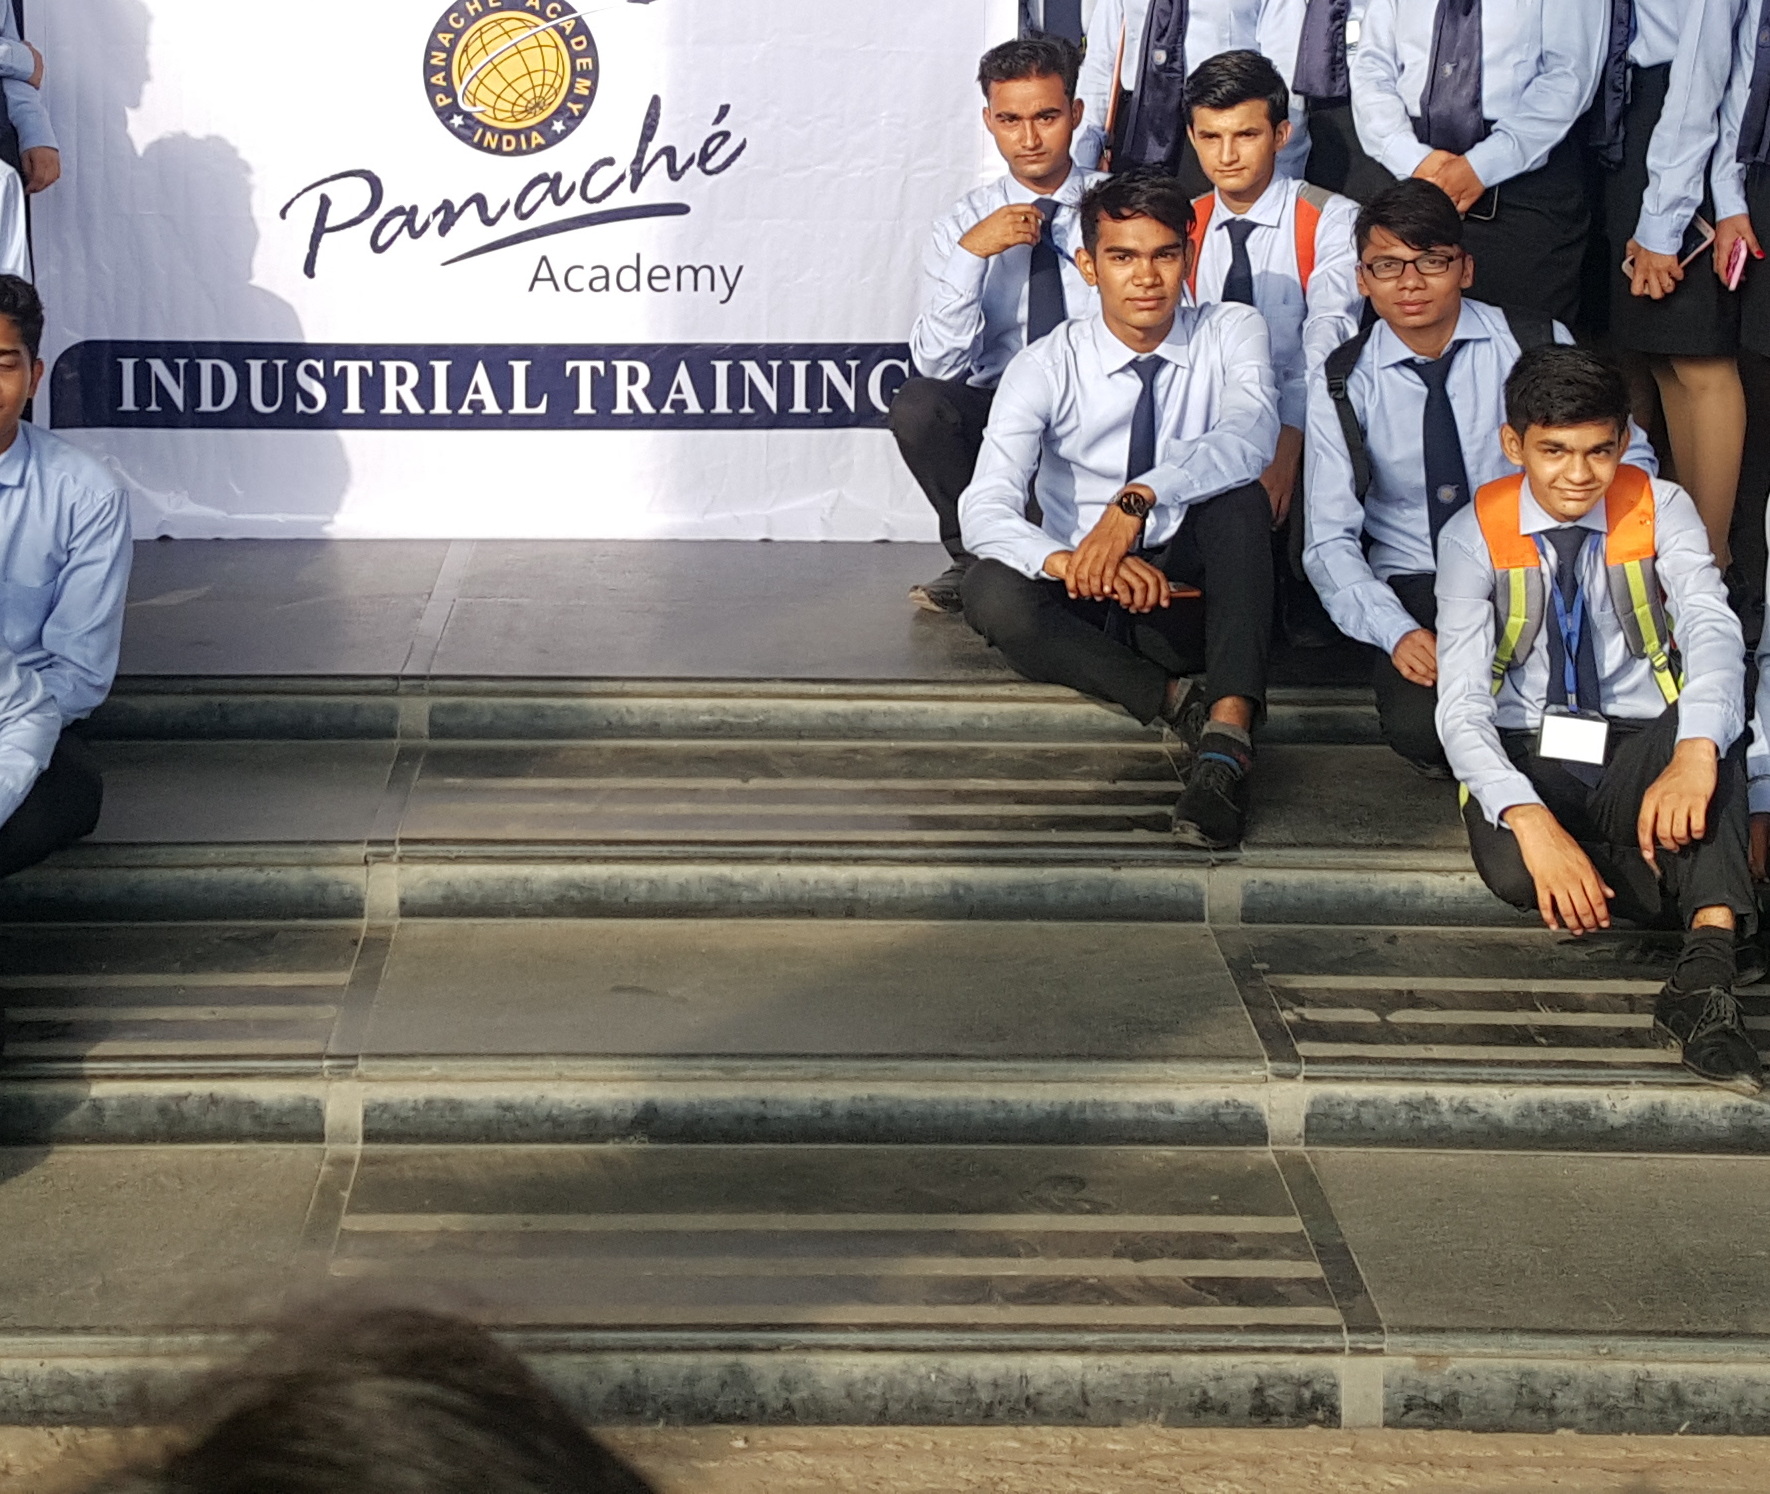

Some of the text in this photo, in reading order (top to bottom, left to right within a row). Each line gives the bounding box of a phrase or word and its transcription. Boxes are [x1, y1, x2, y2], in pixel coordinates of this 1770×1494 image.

[473, 128, 546, 152] INDIA
[280, 94, 746, 279] Panaché
[529, 253, 743, 304] Academy
[117, 358, 910, 416] INDUSTRIAL TRAINING
